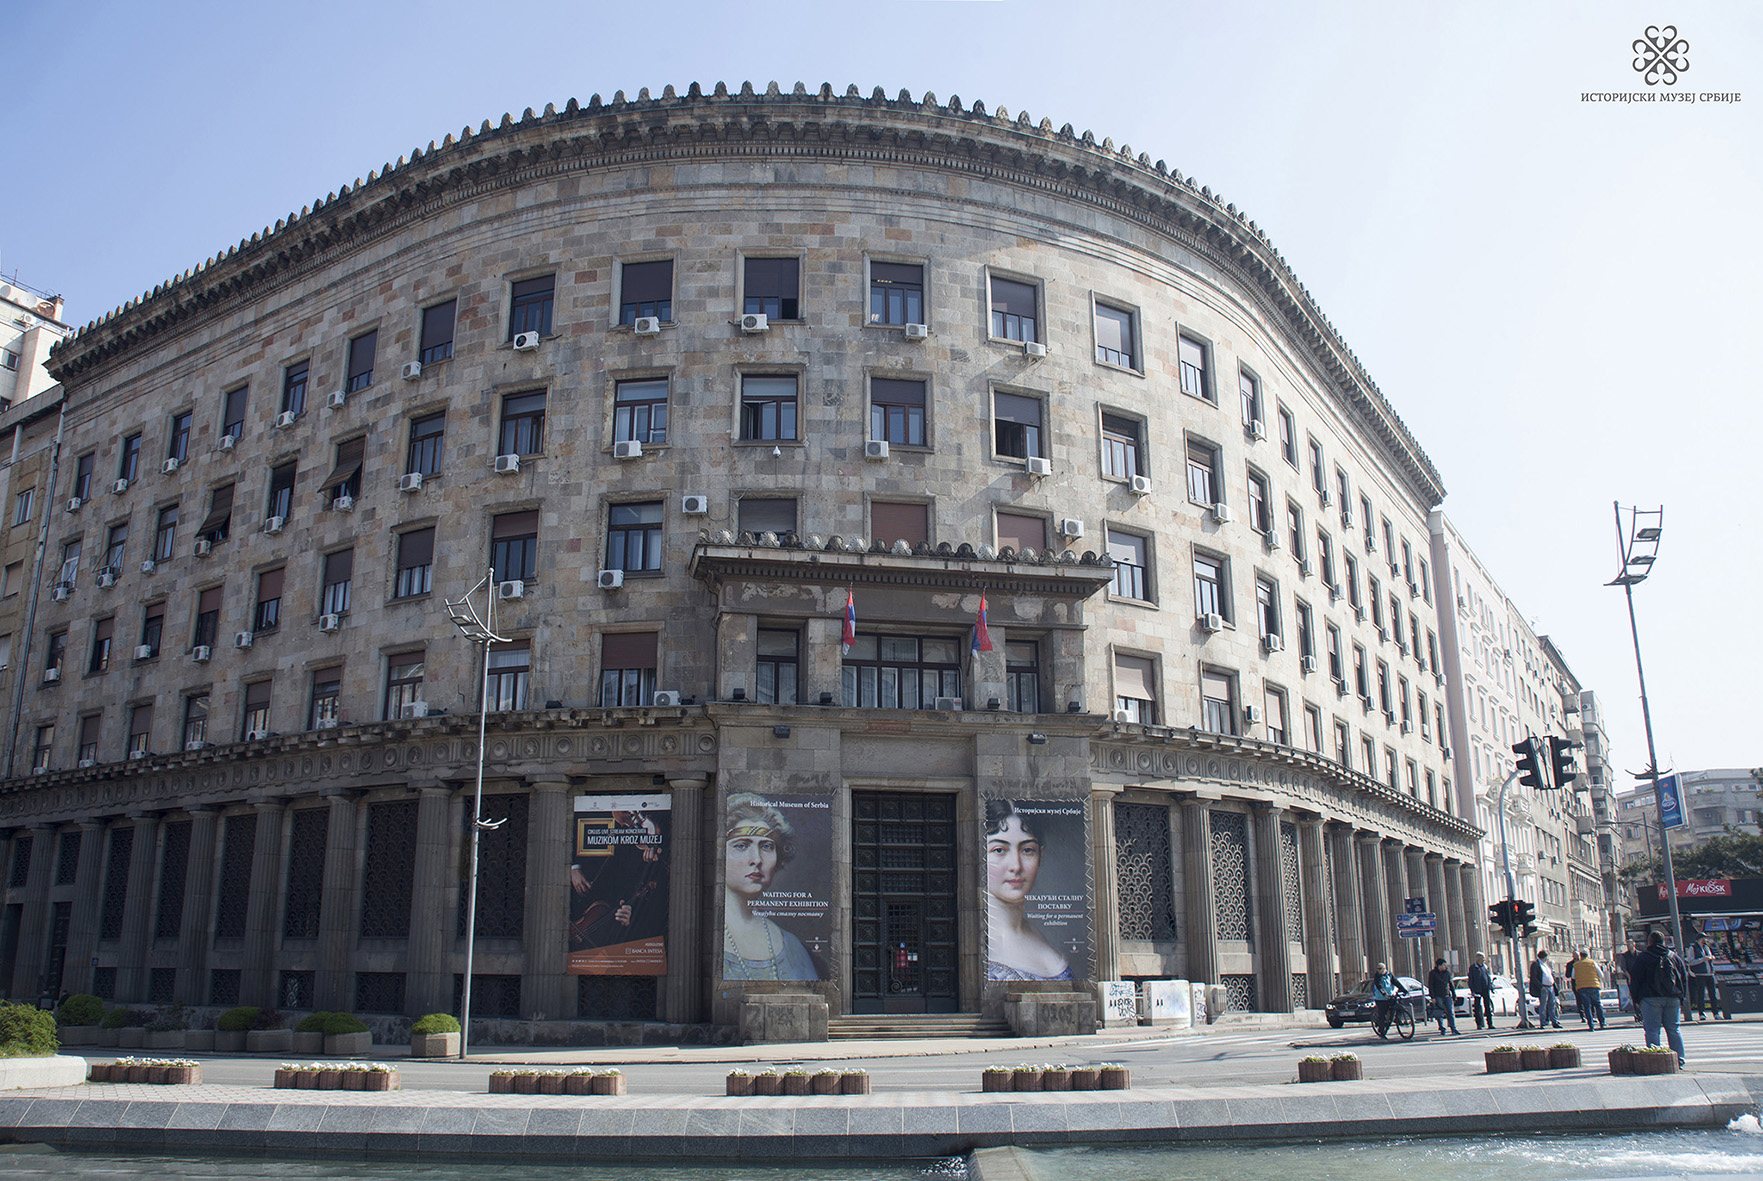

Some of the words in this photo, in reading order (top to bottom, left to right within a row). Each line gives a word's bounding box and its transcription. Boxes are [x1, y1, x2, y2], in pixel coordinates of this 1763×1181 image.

[587, 836, 619, 845] MUZIKOM
[620, 835, 639, 844] KROZ
[640, 835, 663, 844] MUZEJ
